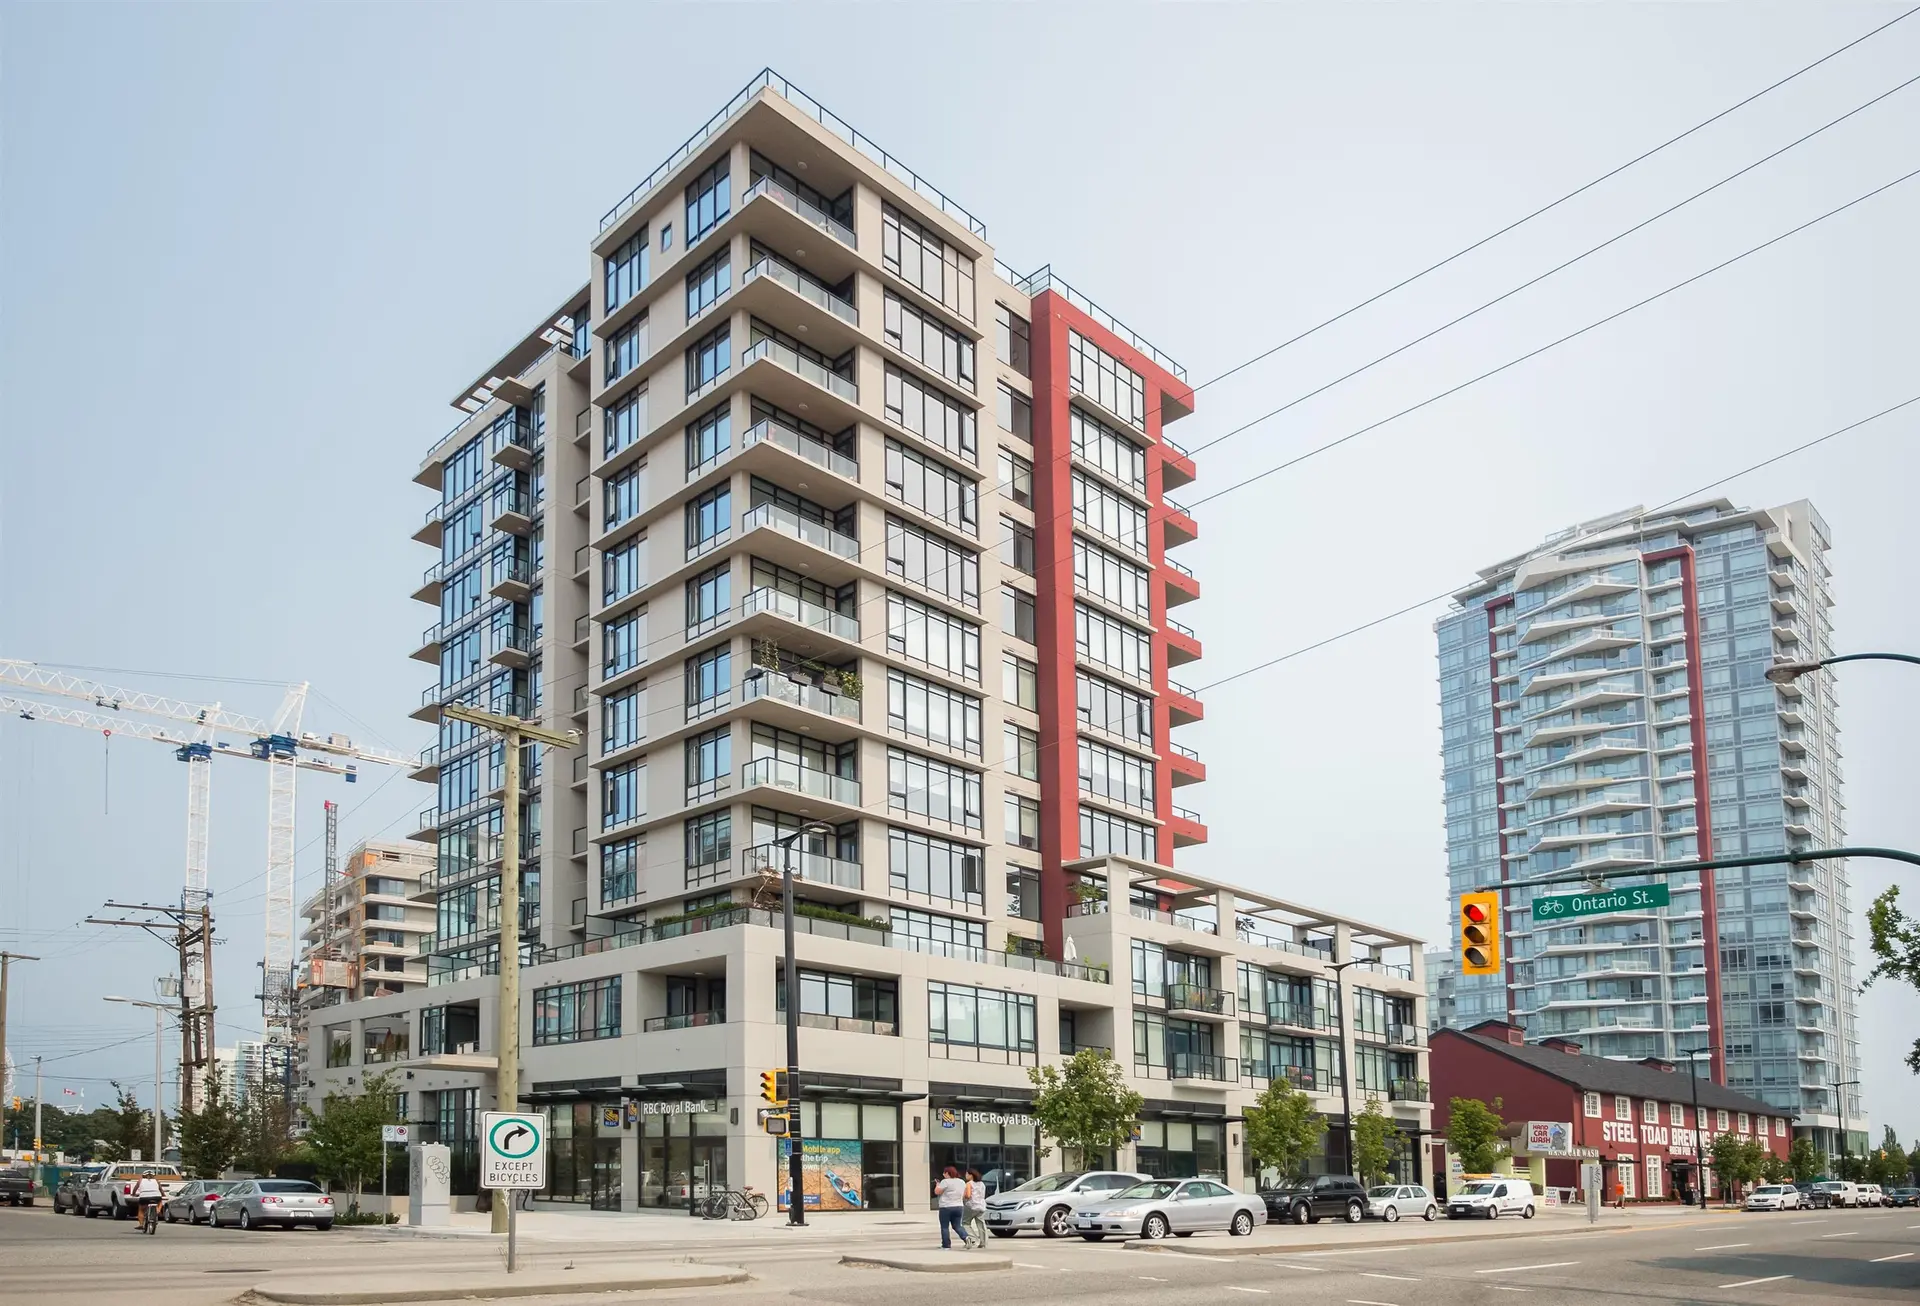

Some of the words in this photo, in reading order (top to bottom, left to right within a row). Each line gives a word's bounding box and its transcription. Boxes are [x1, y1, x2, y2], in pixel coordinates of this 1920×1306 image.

[1572, 893, 1627, 911] Ontario
[1632, 890, 1654, 905] St.
[643, 1102, 659, 1115] RBC
[661, 1101, 683, 1116] Royal
[685, 1100, 708, 1113] Bank
[964, 1112, 987, 1123] RBC
[990, 1113, 1019, 1127] Royal
[1602, 1121, 1637, 1143] STEEL
[1640, 1124, 1668, 1146] TOAD
[1672, 1127, 1711, 1149] BREWNG
[815, 1154, 829, 1163] trip
[1582, 1148, 1600, 1158] WASH
[495, 1161, 533, 1170] EXCEPT
[489, 1173, 538, 1182] BICYCLES
